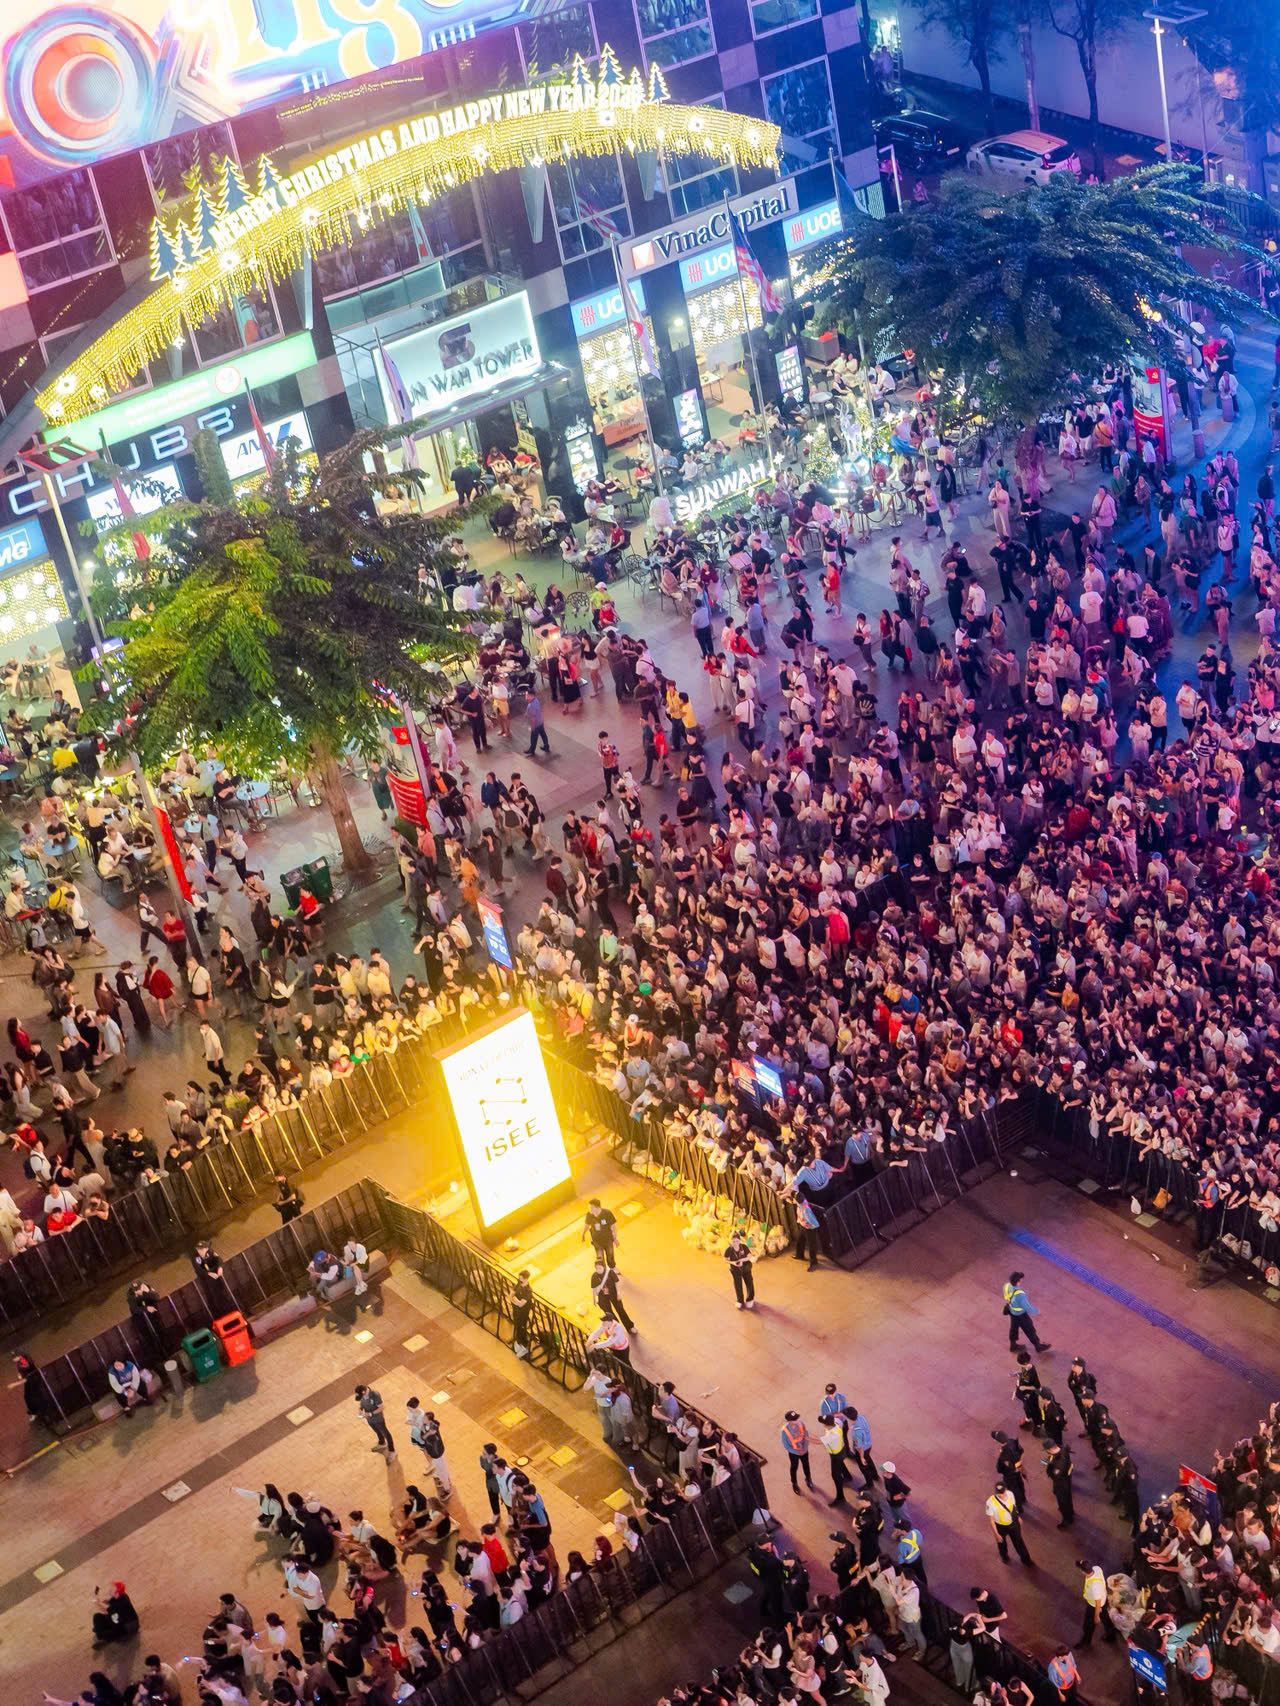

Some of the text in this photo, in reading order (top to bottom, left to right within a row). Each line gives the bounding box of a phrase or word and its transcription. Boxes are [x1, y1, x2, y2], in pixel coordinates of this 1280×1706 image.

[208, 187, 278, 248] MERRY
[279, 130, 398, 206] CHRISTMAS
[400, 114, 440, 149] AND
[441, 95, 503, 135] HAPPY
[503, 87, 545, 119] NEW
[548, 83, 598, 112] YEAR
[806, 207, 841, 235] UOB
[430, 367, 472, 393] WAH
[476, 337, 534, 379] TOWER
[675, 459, 766, 520] SUNWAH
[484, 1117, 541, 1162] ISEE
